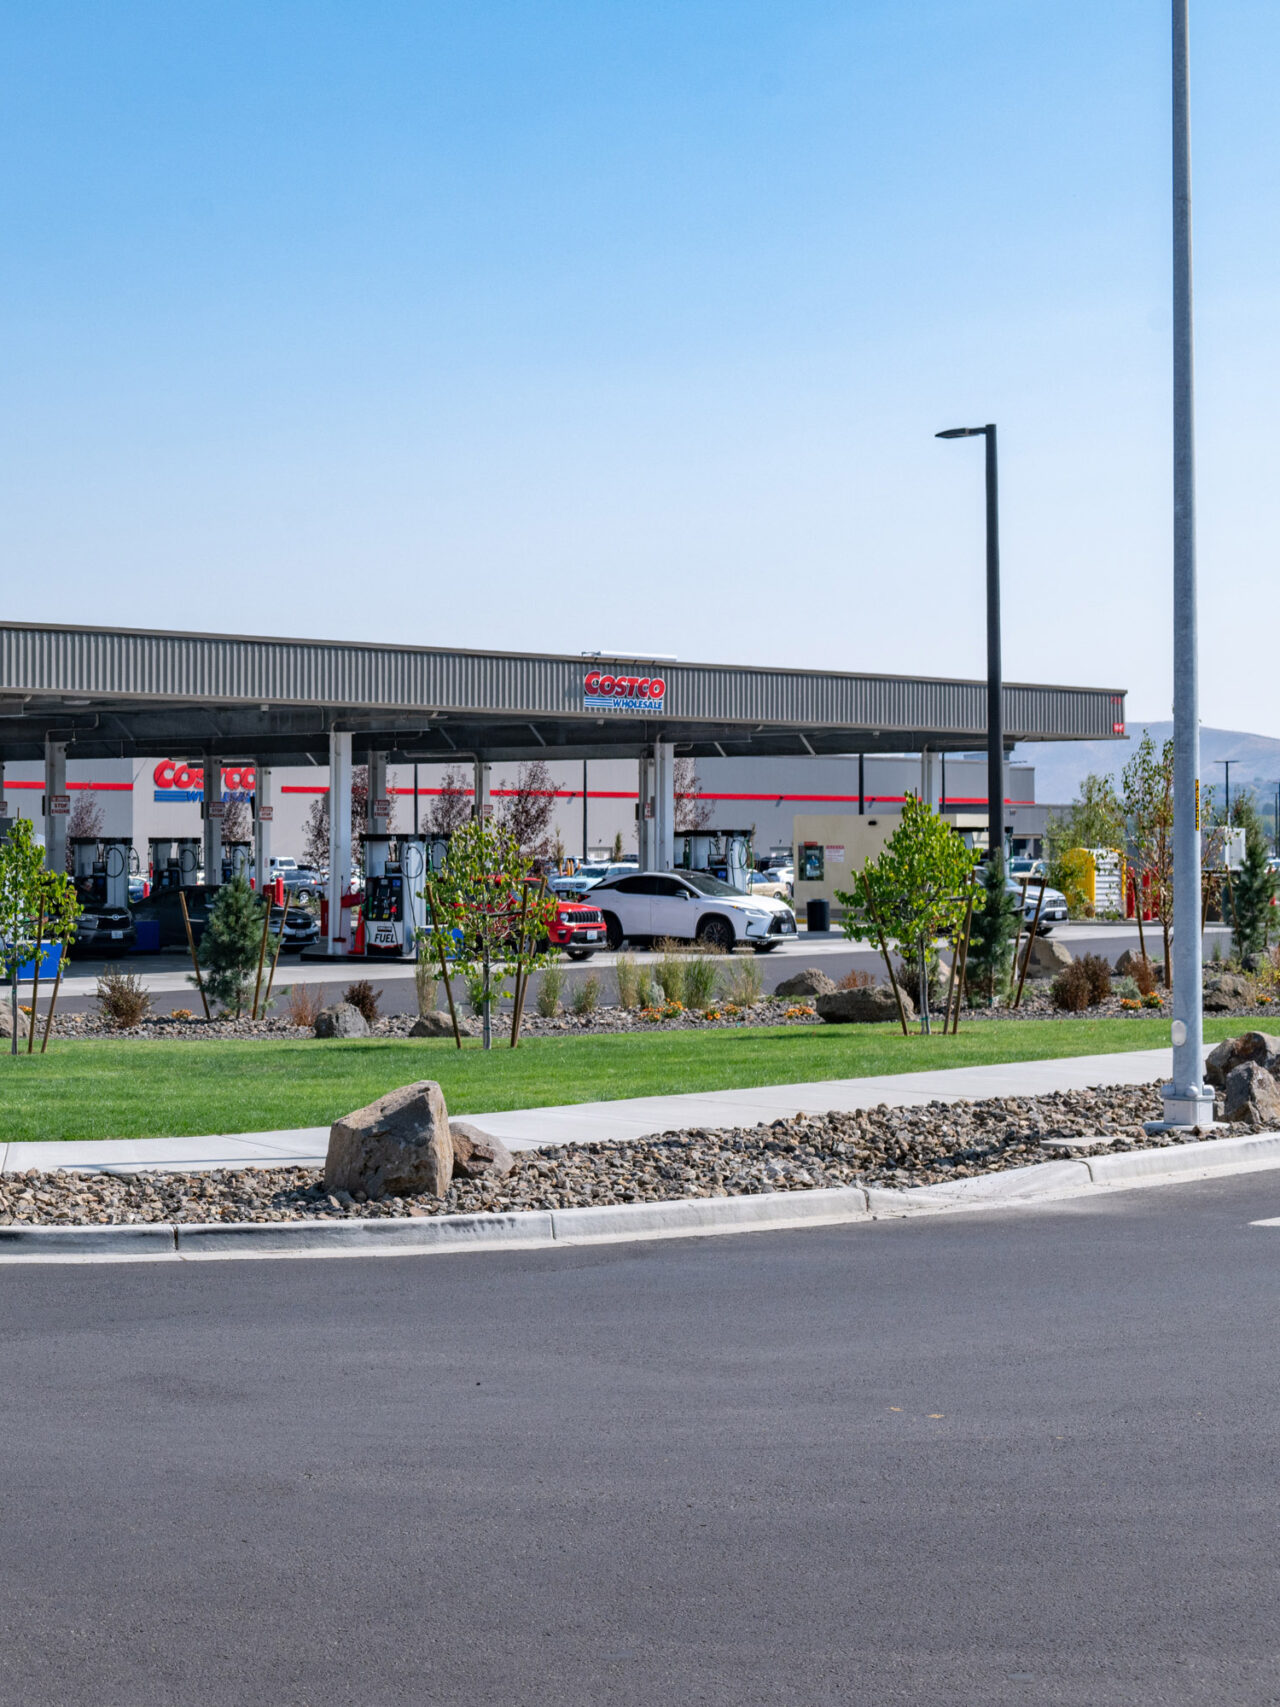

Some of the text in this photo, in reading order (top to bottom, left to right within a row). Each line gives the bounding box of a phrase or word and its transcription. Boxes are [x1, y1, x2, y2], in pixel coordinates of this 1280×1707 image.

[584, 671, 665, 699] COSTCO
[613, 699, 663, 709] WHOLESALE
[374, 933, 395, 943] FUEL
